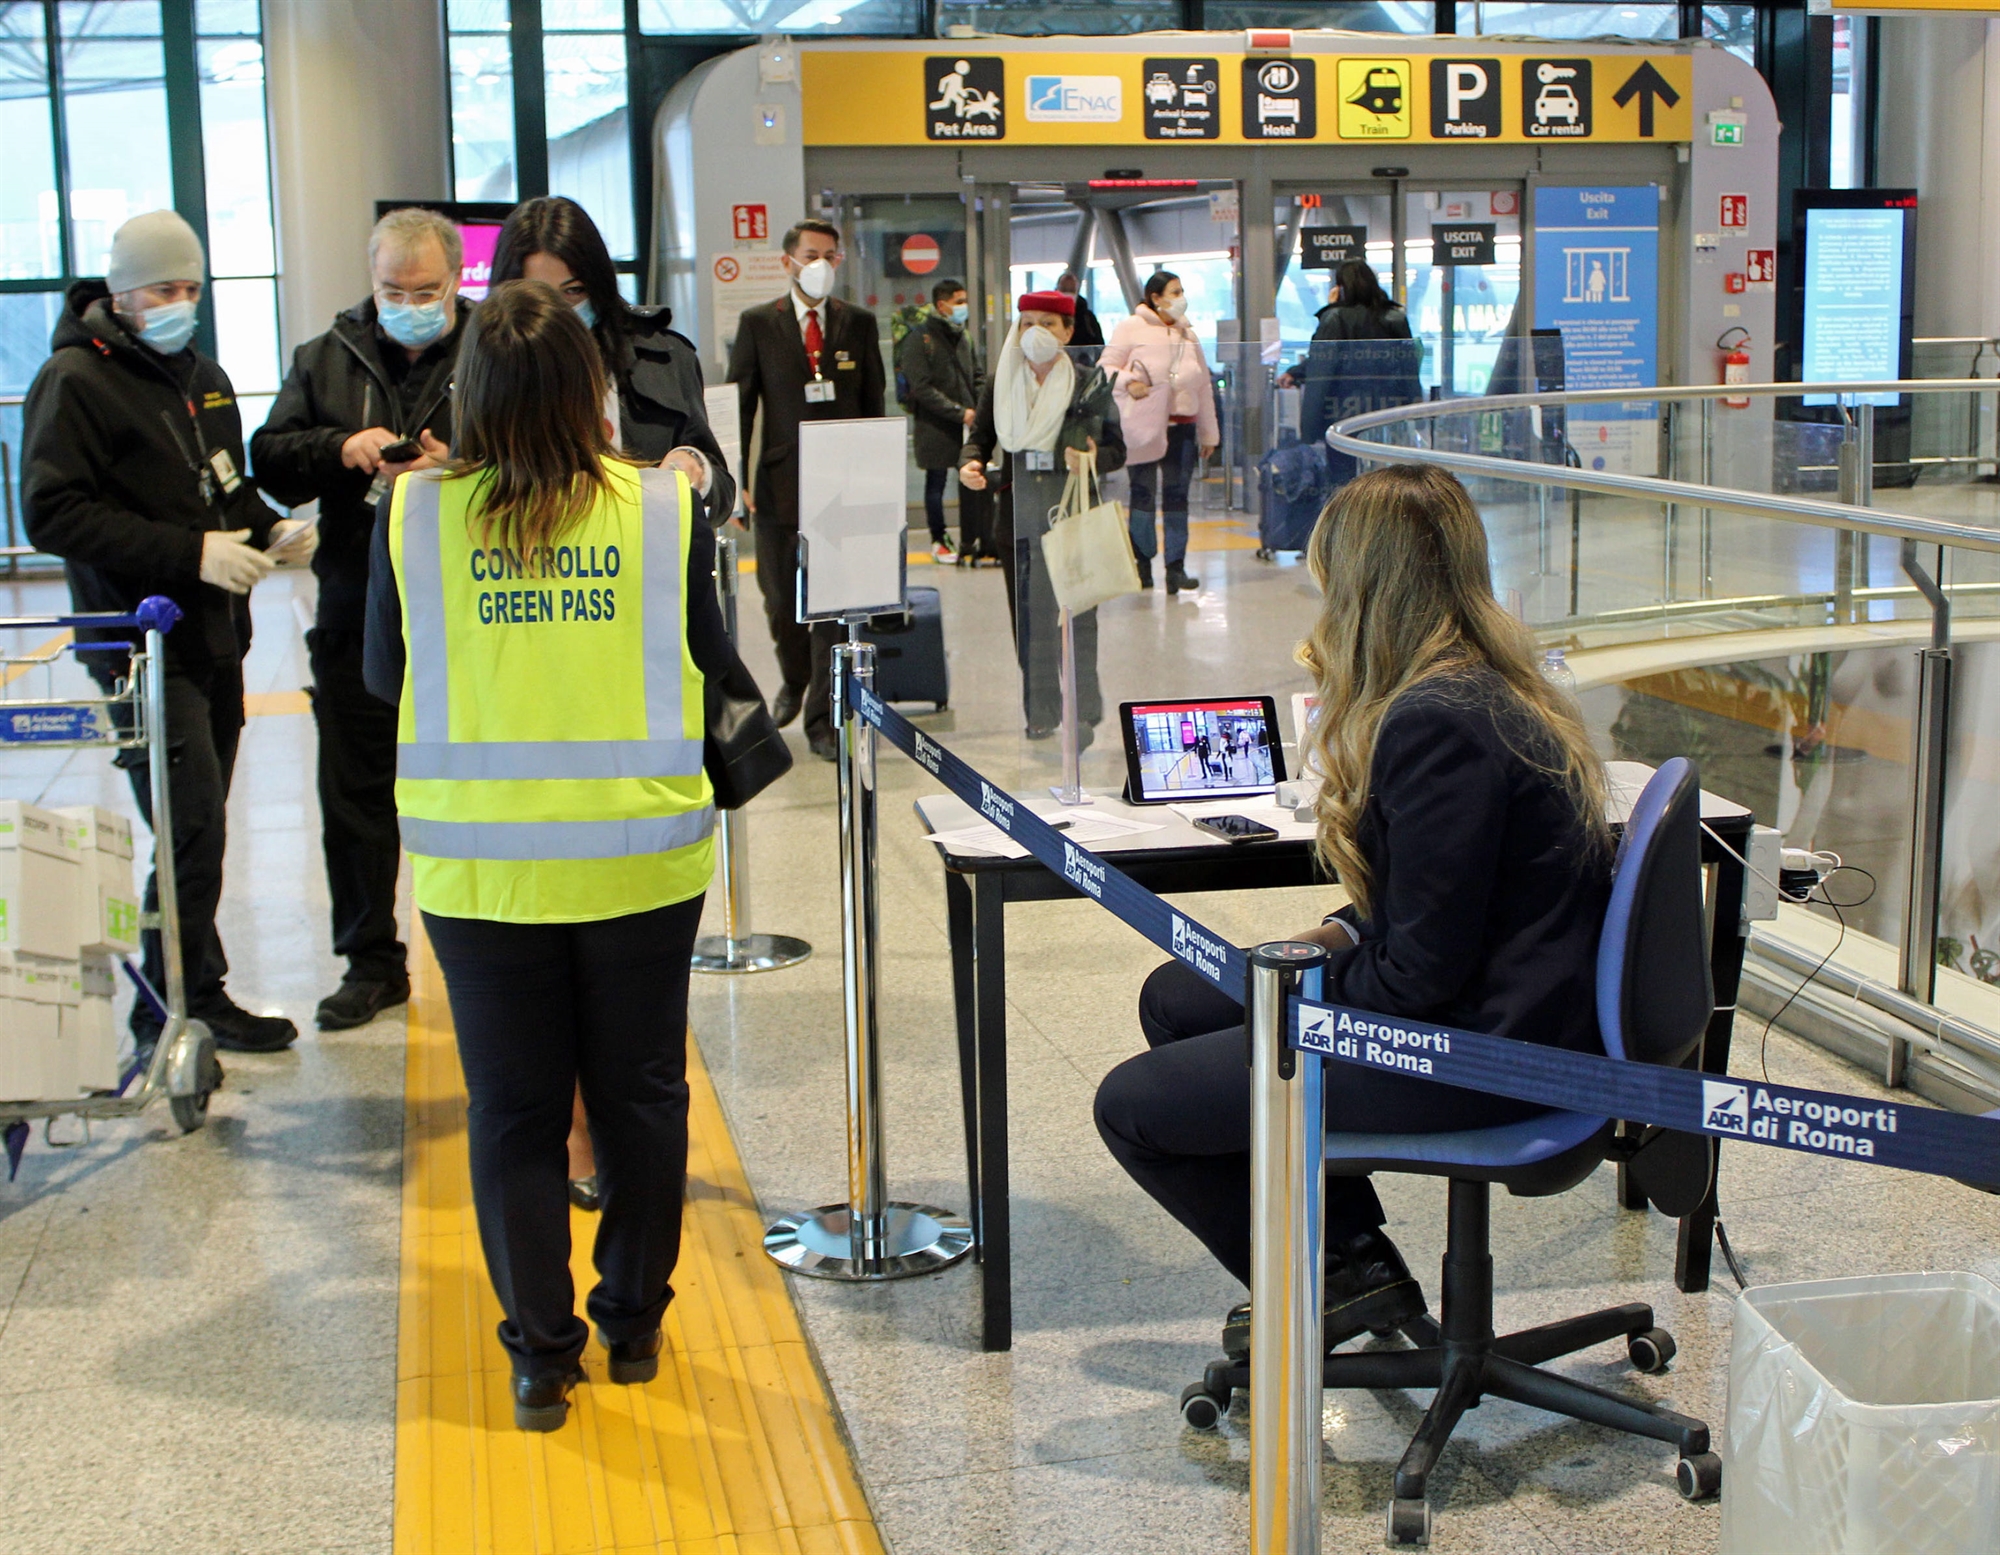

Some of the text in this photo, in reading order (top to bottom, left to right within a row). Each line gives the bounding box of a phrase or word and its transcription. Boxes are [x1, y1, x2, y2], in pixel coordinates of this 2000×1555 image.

[934, 121, 998, 136] Pet Area
[1262, 123, 1296, 136] Hotel
[1360, 124, 1388, 135] Train
[1444, 122, 1487, 138] Parking
[1530, 123, 1585, 135] Car rental
[1580, 191, 1615, 204] Uscita
[1586, 207, 1609, 219] Exit
[1312, 234, 1355, 246] USCITA
[1443, 231, 1484, 243] USCITA
[1321, 249, 1347, 262] EXIT
[1451, 246, 1477, 258] EXIT
[478, 588, 615, 625] GREEN PASS
[990, 787, 1014, 817] Aeroporti
[989, 804, 1010, 831] di Roma
[1075, 849, 1106, 882] Aeroporti
[1075, 867, 1101, 898] di Roma
[1186, 922, 1227, 964] Aeroporti
[1186, 944, 1220, 982] di Roma
[1301, 1031, 1332, 1050] ADR
[1337, 1012, 1450, 1054] Aeroporti
[1337, 1037, 1433, 1075] di Roma
[1751, 1088, 1897, 1133] Aeroporti
[1706, 1110, 1744, 1132] ADR
[1751, 1115, 1875, 1157] di Roma
